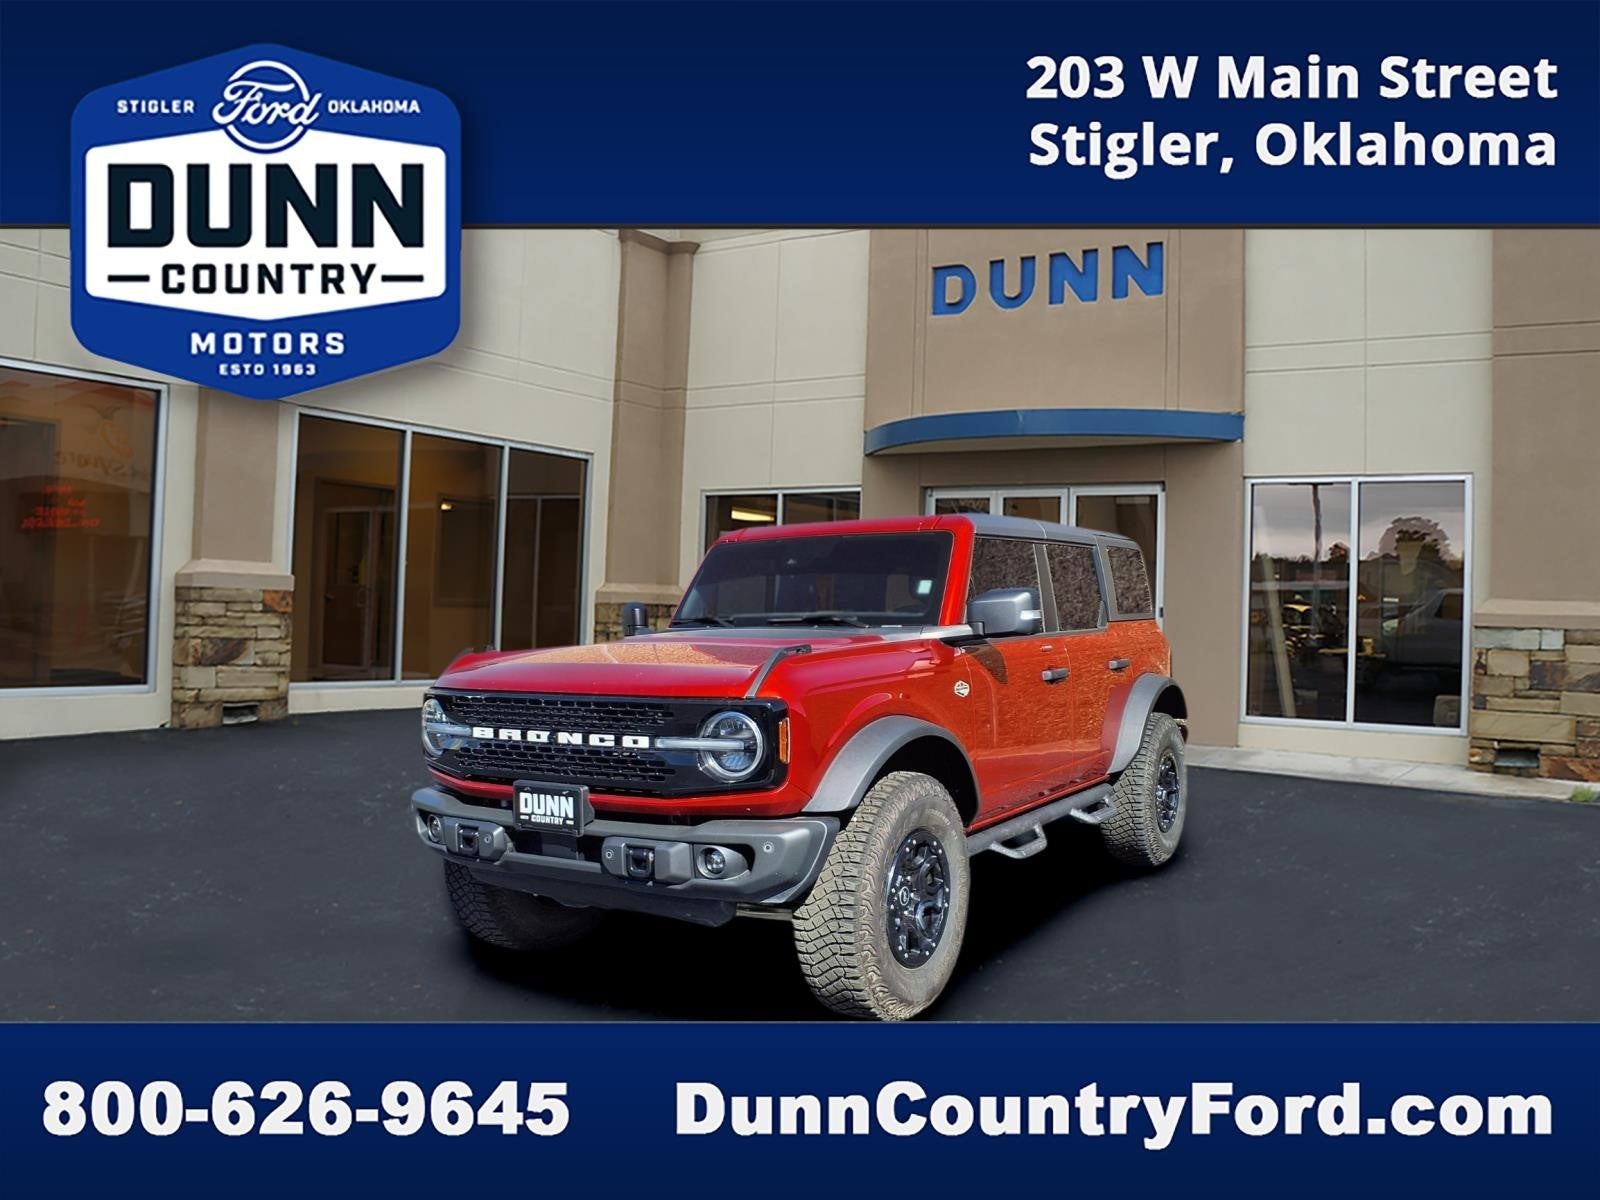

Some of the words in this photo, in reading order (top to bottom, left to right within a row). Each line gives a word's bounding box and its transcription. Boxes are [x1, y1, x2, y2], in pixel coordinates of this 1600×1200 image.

[931, 241, 1164, 316] DUNN
[472, 726, 650, 749] BRONCO
[519, 791, 575, 819] DUNN
[530, 814, 564, 826] COUNTRY
